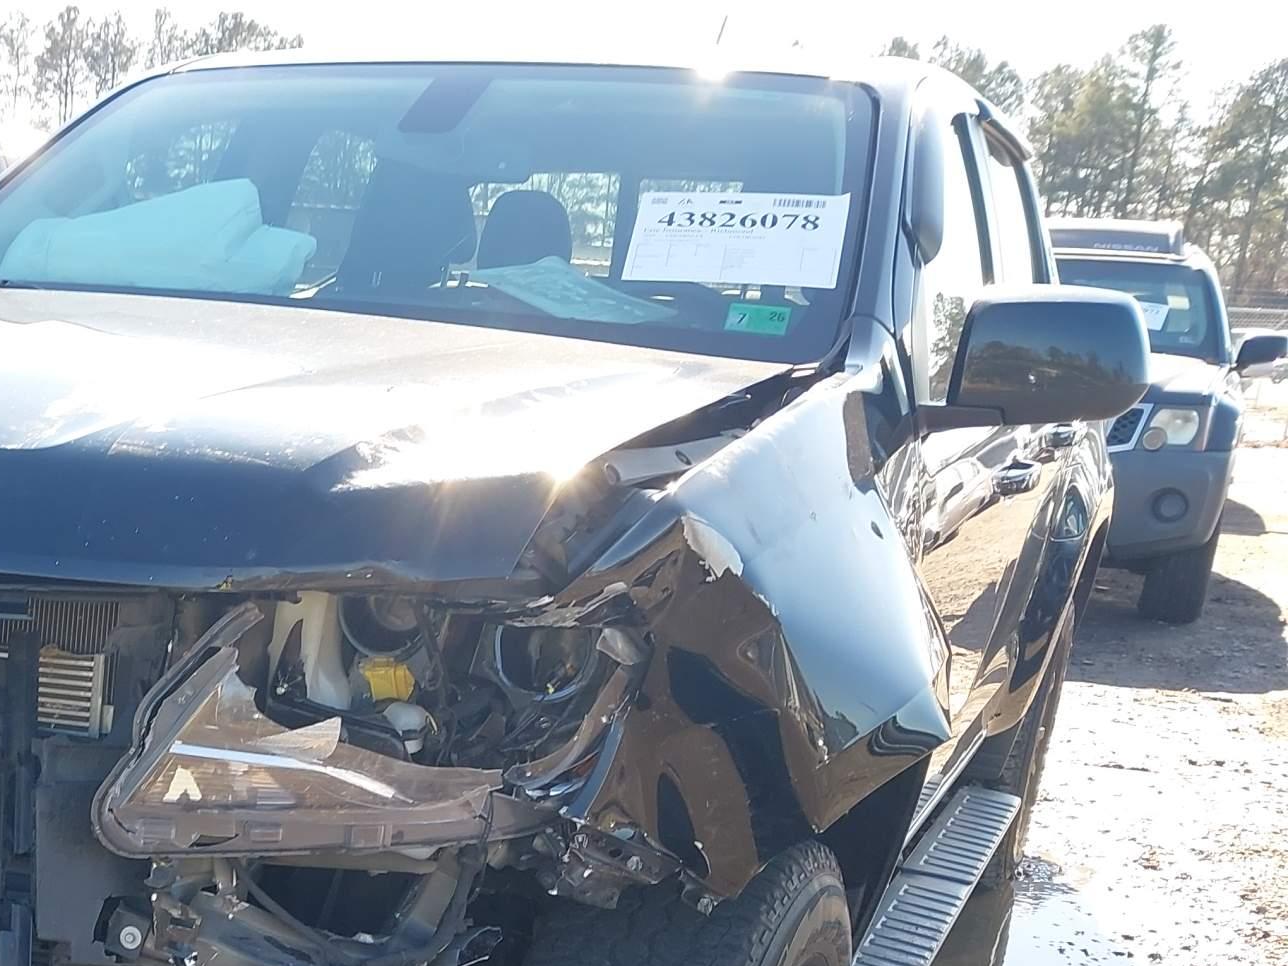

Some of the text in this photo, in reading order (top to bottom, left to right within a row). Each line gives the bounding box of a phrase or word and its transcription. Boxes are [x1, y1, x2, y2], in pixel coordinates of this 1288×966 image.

[657, 211, 820, 231] 43826078
[737, 311, 785, 324] 7 26
